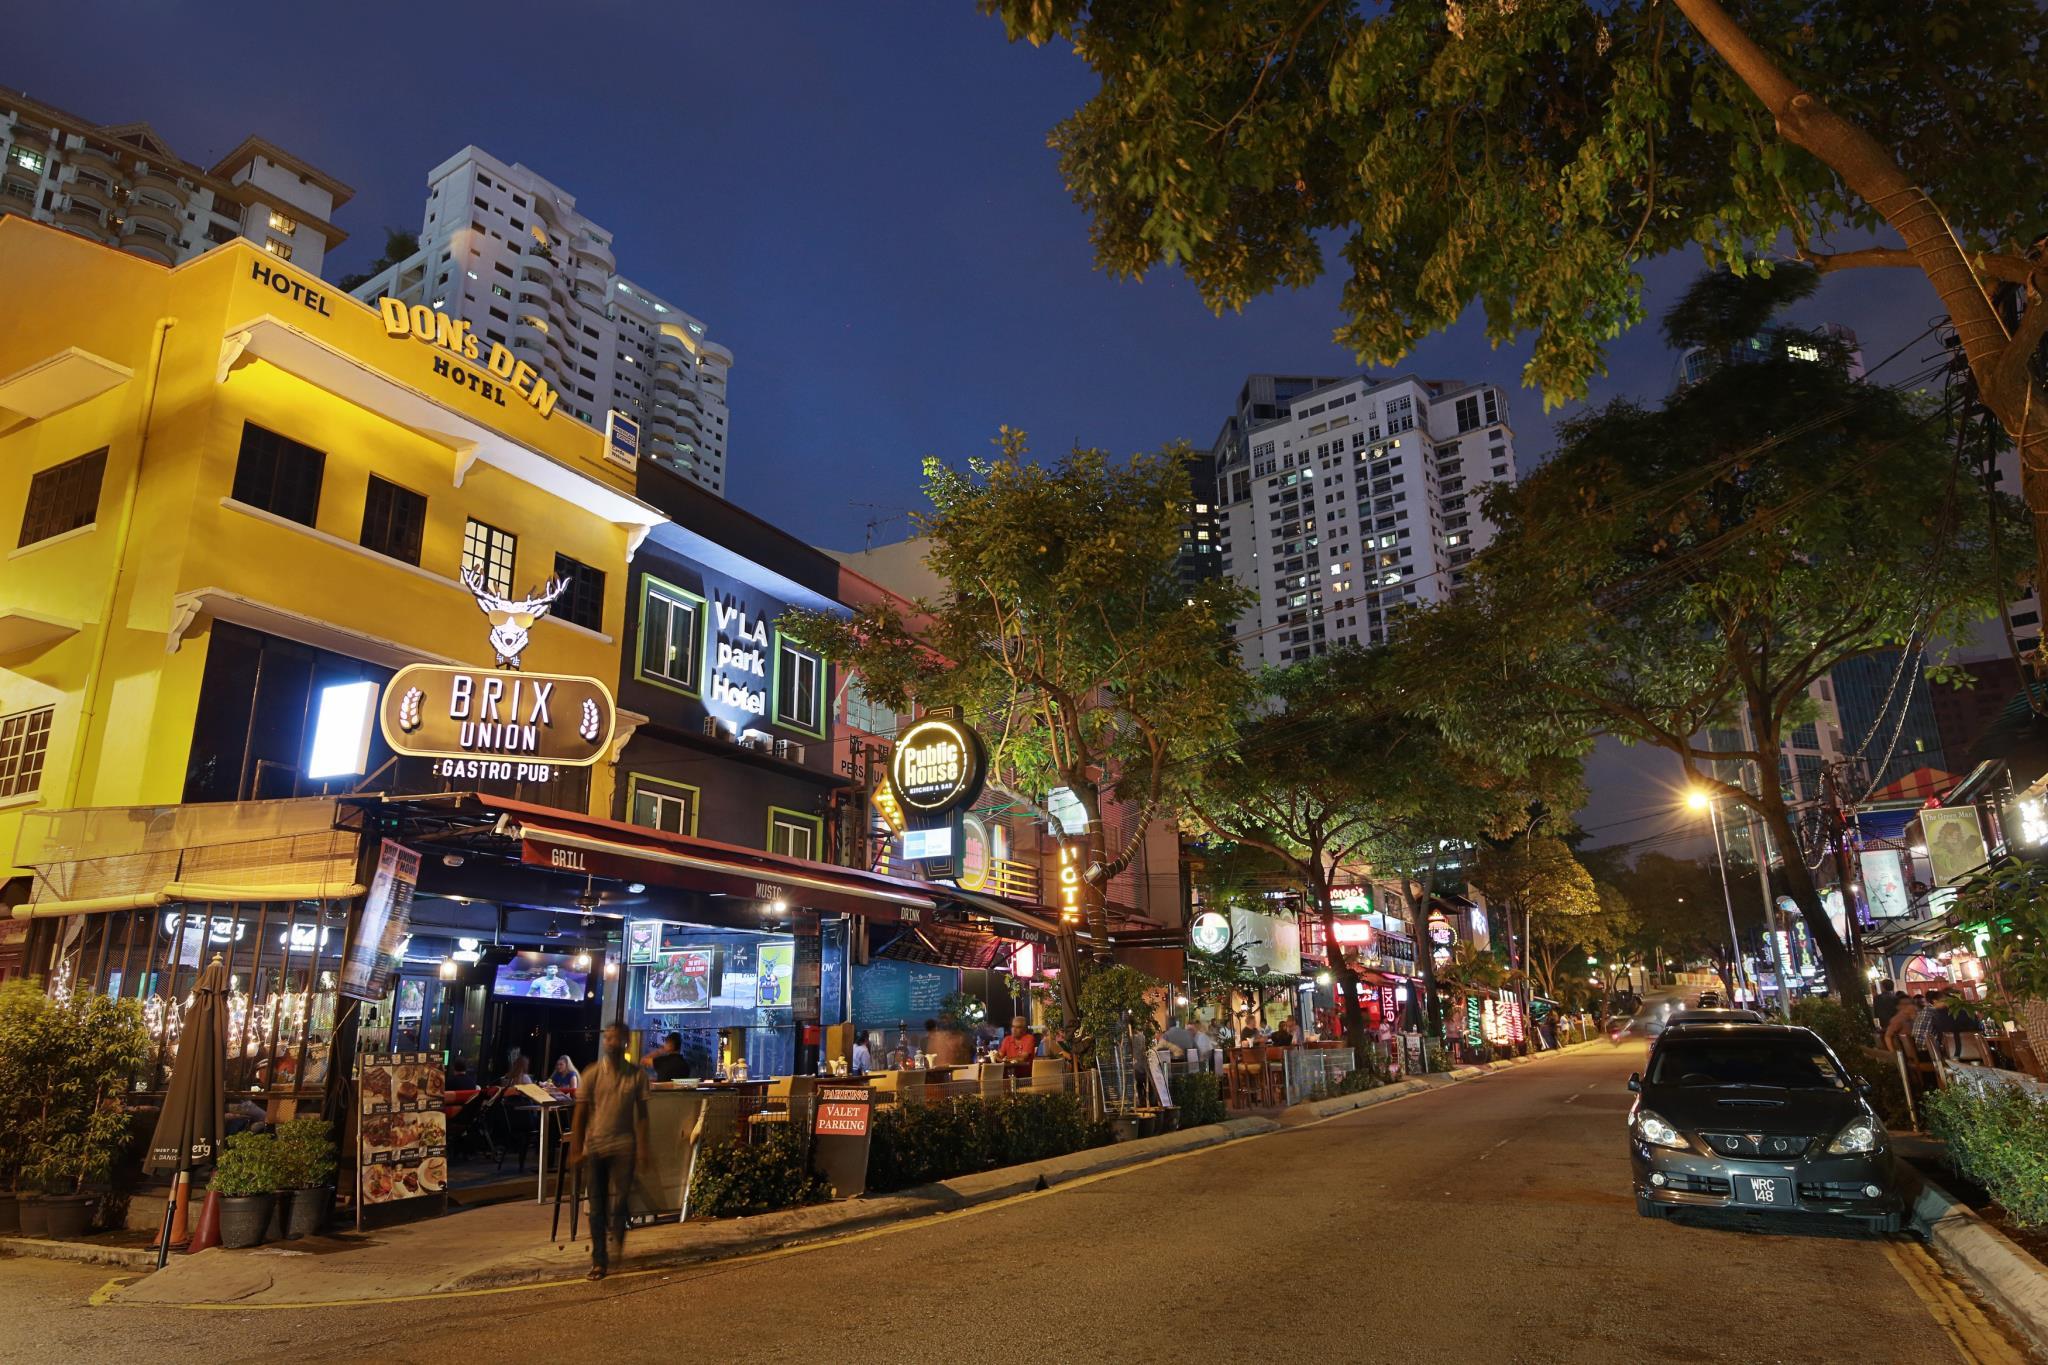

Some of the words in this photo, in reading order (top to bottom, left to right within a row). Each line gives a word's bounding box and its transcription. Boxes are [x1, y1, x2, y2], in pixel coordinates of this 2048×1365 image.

[251, 261, 331, 318] HOTEL
[432, 355, 506, 407] HOTEL
[488, 341, 559, 419] DEN
[450, 675, 553, 724] BRIX
[712, 673, 766, 716] Hotel
[460, 721, 537, 751] UNION
[905, 741, 958, 768] Public
[442, 759, 512, 780] GASTRO
[517, 763, 549, 782] PUB
[905, 763, 958, 787] House
[1958, 811, 1973, 819] Man
[551, 848, 586, 871] GRILL
[755, 882, 782, 900] MUSIC
[900, 907, 921, 922] DRINK
[1021, 929, 1039, 942] Food
[823, 1089, 869, 1101] PARKING
[827, 1106, 861, 1117] VALET
[818, 1119, 865, 1130] PARKING
[192, 1144, 211, 1157] erg
[1750, 1177, 1775, 1190] WRC
[1754, 1190, 1774, 1202] 148
